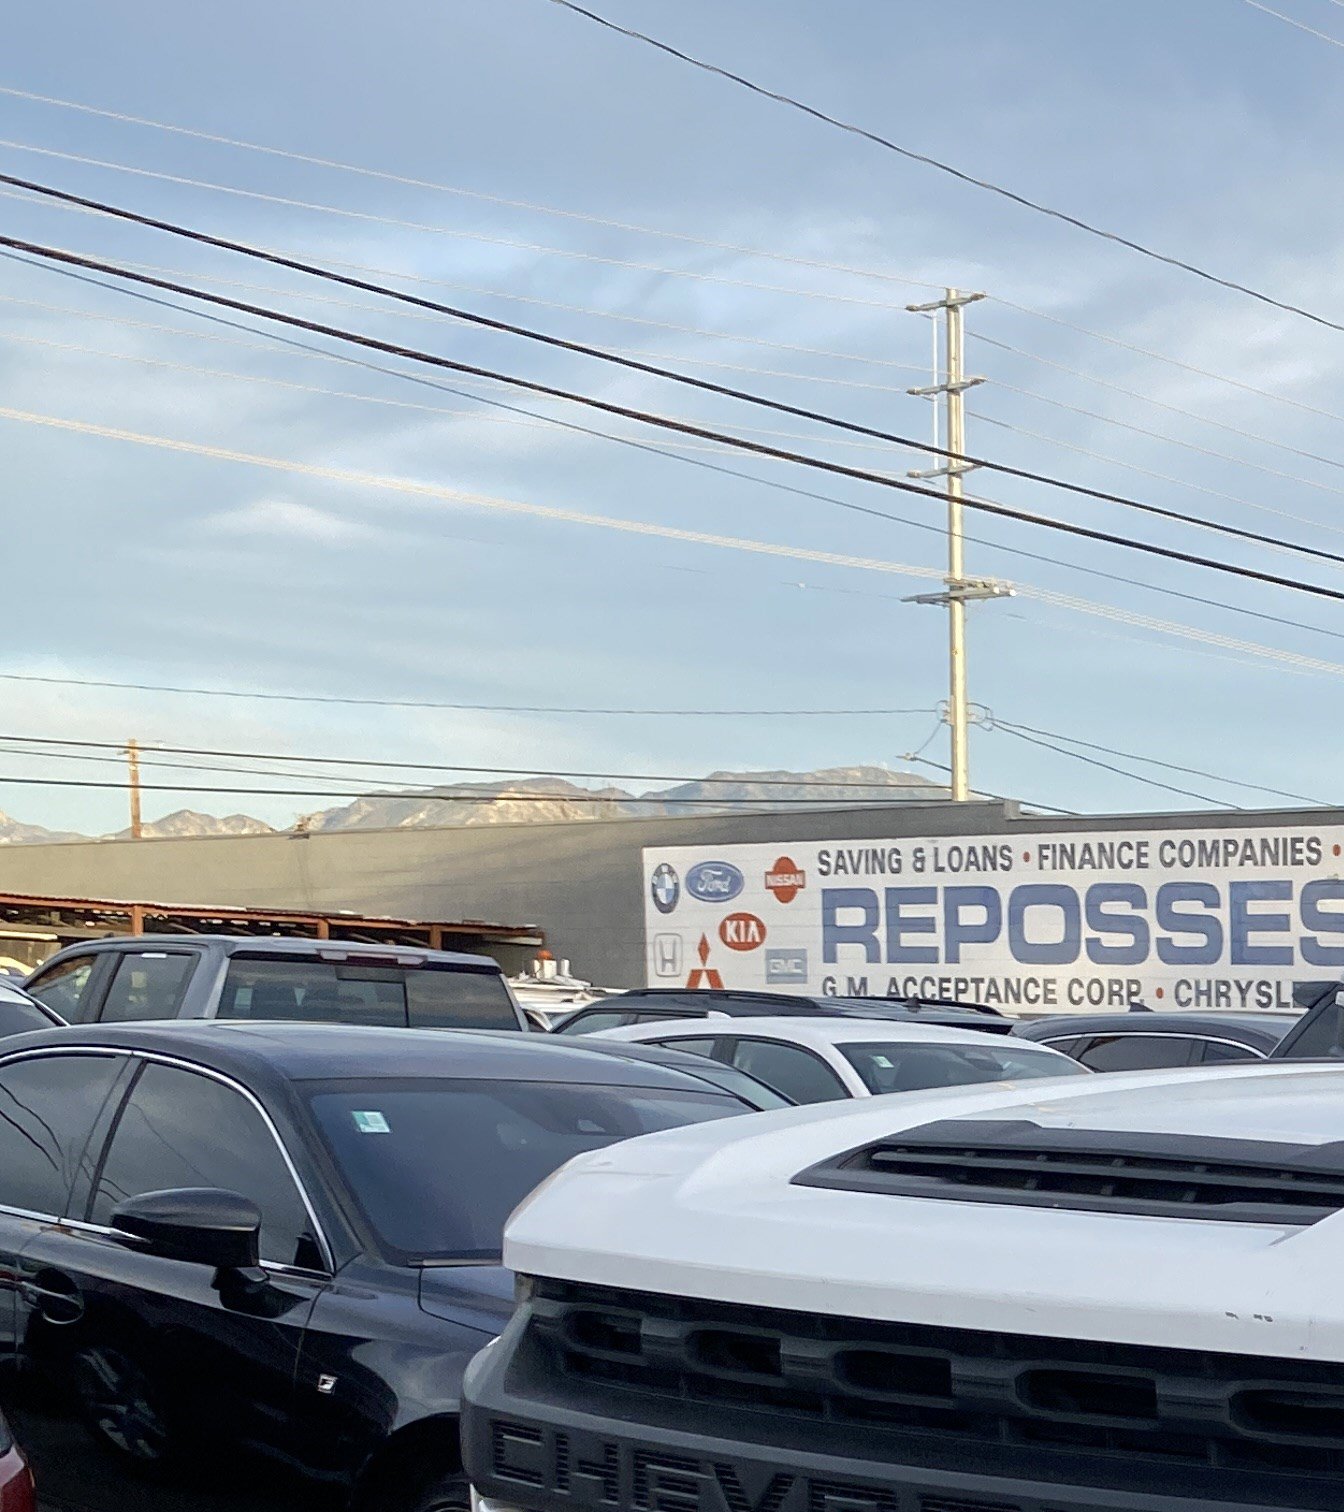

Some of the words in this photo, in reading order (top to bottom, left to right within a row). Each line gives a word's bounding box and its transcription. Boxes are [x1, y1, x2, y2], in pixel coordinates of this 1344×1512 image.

[817, 846, 902, 876] SAVING
[912, 846, 925, 873] &
[934, 843, 1013, 873] LOANS
[1037, 840, 1149, 871] FINANCE
[1158, 836, 1323, 869] COMPANIES
[697, 868, 732, 894] Ford
[766, 873, 804, 887] NISSAN
[725, 920, 761, 944] KIA
[822, 975, 876, 997] G.M.
[886, 976, 1056, 1005] ACCEPTANCE
[1174, 978, 1309, 1008] CHRYSL
